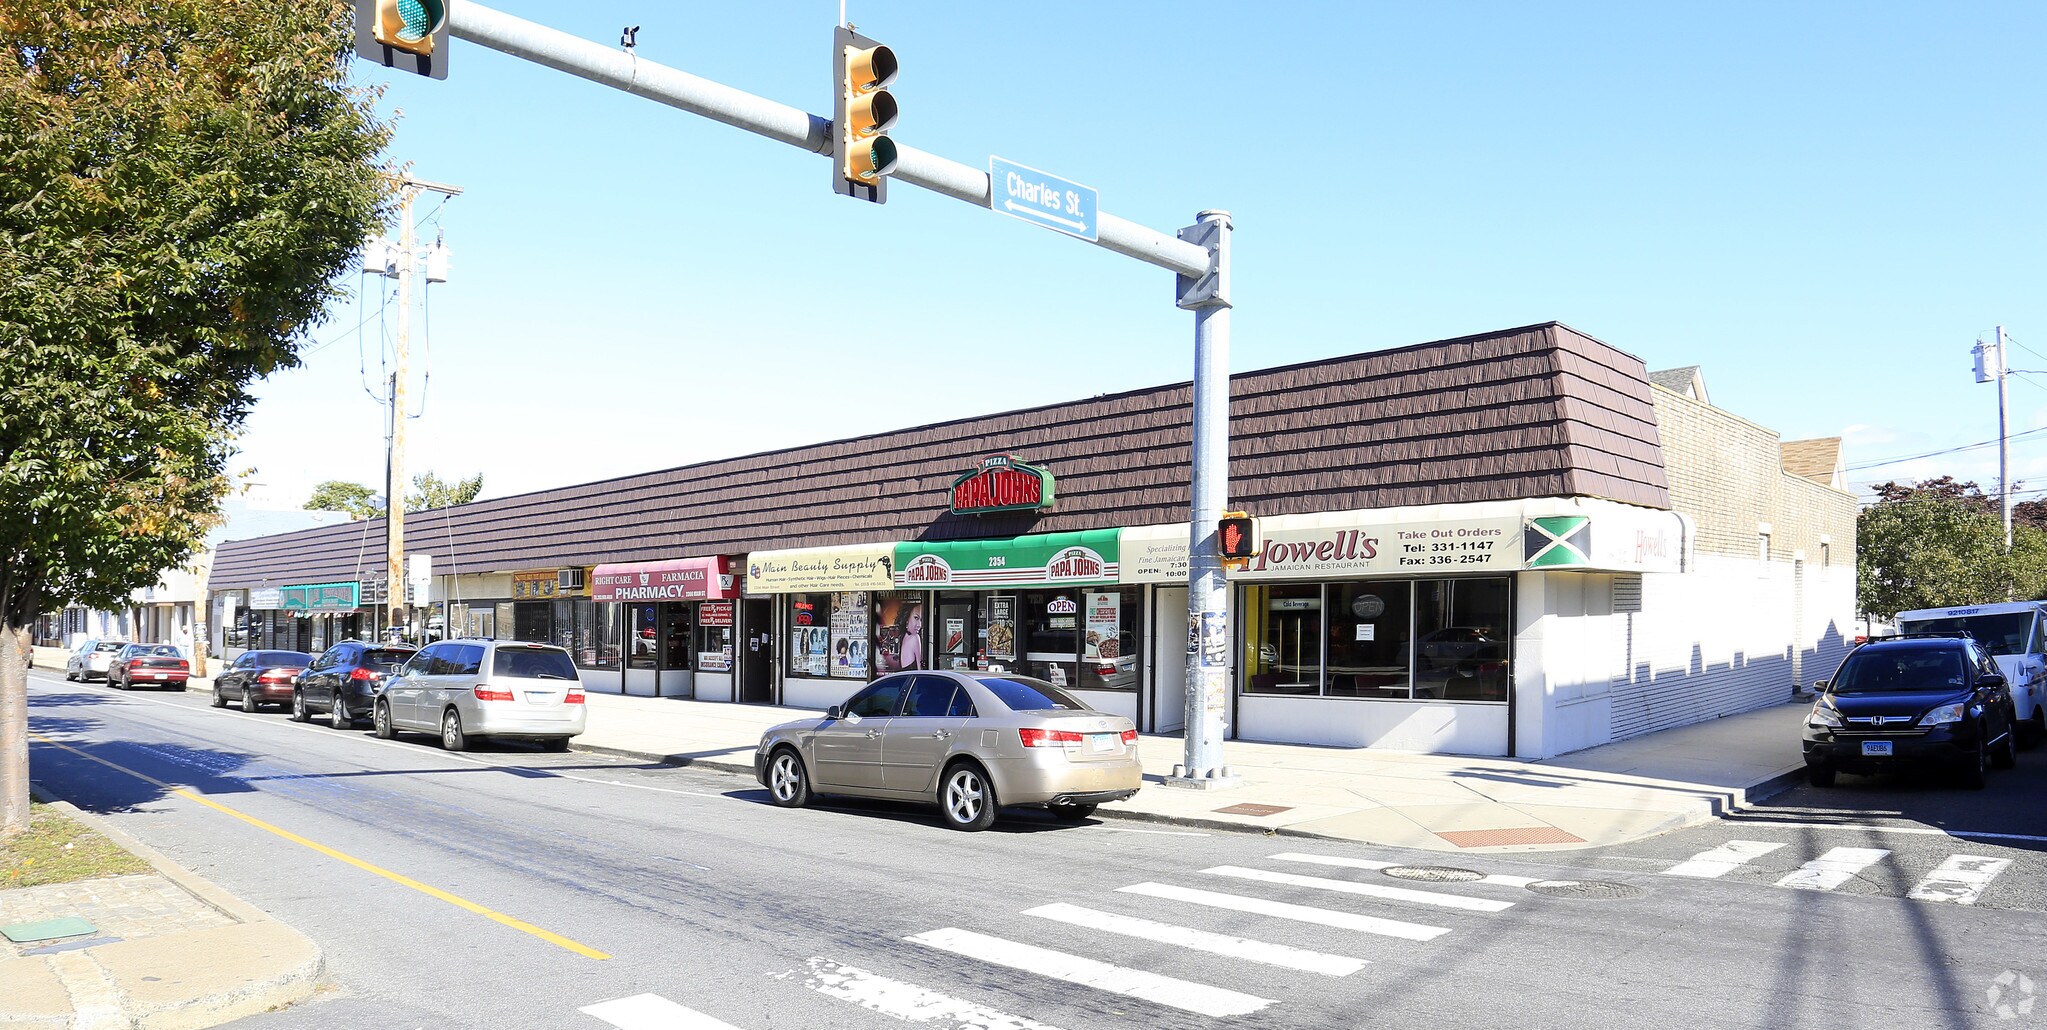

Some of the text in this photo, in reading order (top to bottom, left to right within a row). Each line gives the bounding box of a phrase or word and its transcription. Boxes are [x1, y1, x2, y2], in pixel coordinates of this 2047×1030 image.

[1007, 171, 1084, 218] Charles St.
[985, 457, 1007, 467] PIZZA
[954, 472, 992, 509] PAPA
[1397, 528, 1502, 540] Take Out Orders
[1146, 544, 1187, 554] Specializing
[1403, 541, 1494, 553] Tel: 331-1147
[988, 556, 1006, 567] 2354
[1153, 555, 1186, 563] Jamaican
[1399, 557, 1426, 566] Fax:
[762, 557, 877, 574] Main Beauty Supply
[1050, 560, 1072, 577] PAPA
[1271, 561, 1370, 572] JAMAICAN RESTAURANT
[661, 571, 705, 582] FARMACIA
[908, 565, 925, 581] PAPA
[595, 576, 632, 585] RIGHT CARE
[615, 584, 684, 599] PHARMACY
[994, 601, 1009, 609] EXTRA
[1049, 602, 1075, 612] OPEN
[1947, 608, 1980, 616] 9210817
